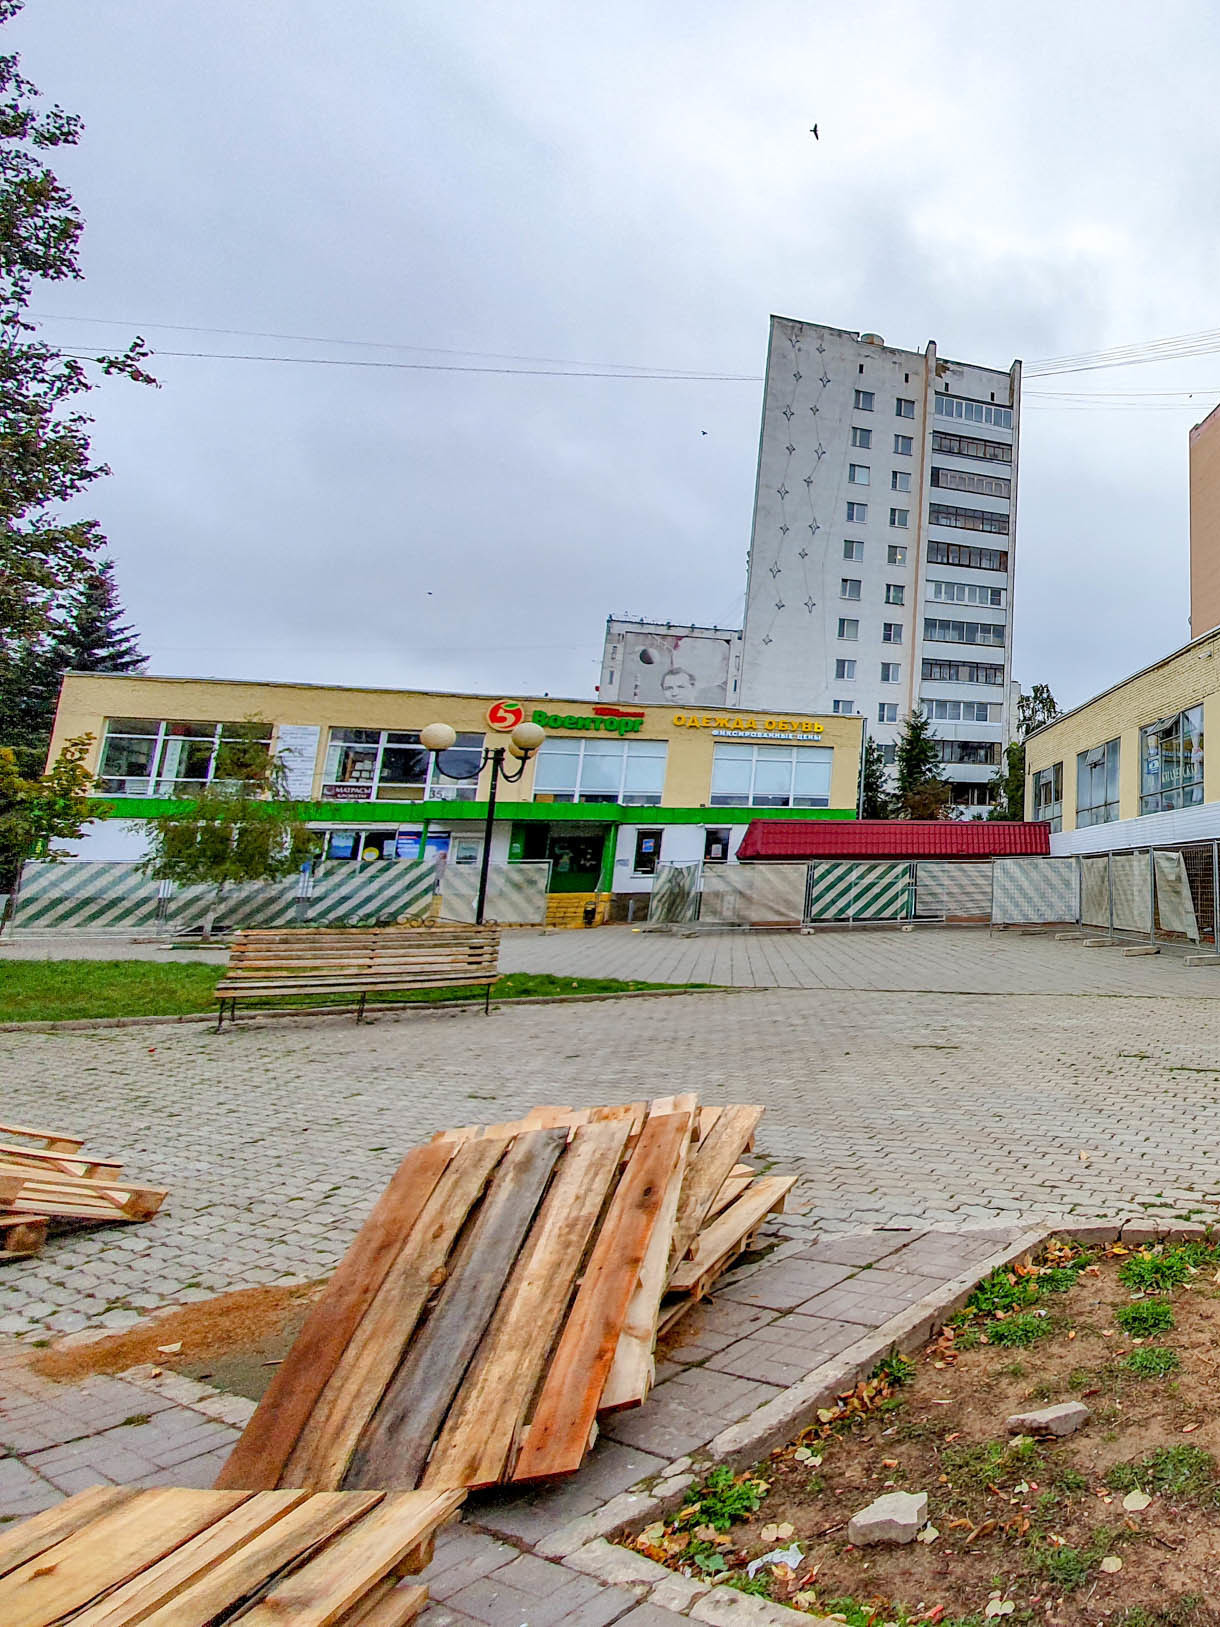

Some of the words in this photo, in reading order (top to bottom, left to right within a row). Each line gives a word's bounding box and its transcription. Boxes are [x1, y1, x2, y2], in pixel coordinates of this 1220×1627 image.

[532, 709, 644, 736] Военторг
[673, 714, 758, 730] ОДЕЖДА
[765, 719, 824, 733] ОБУВЬ
[712, 729, 793, 740] ФИКСИРОВАННЫЕ
[797, 733, 822, 741] ЦЕНЫ
